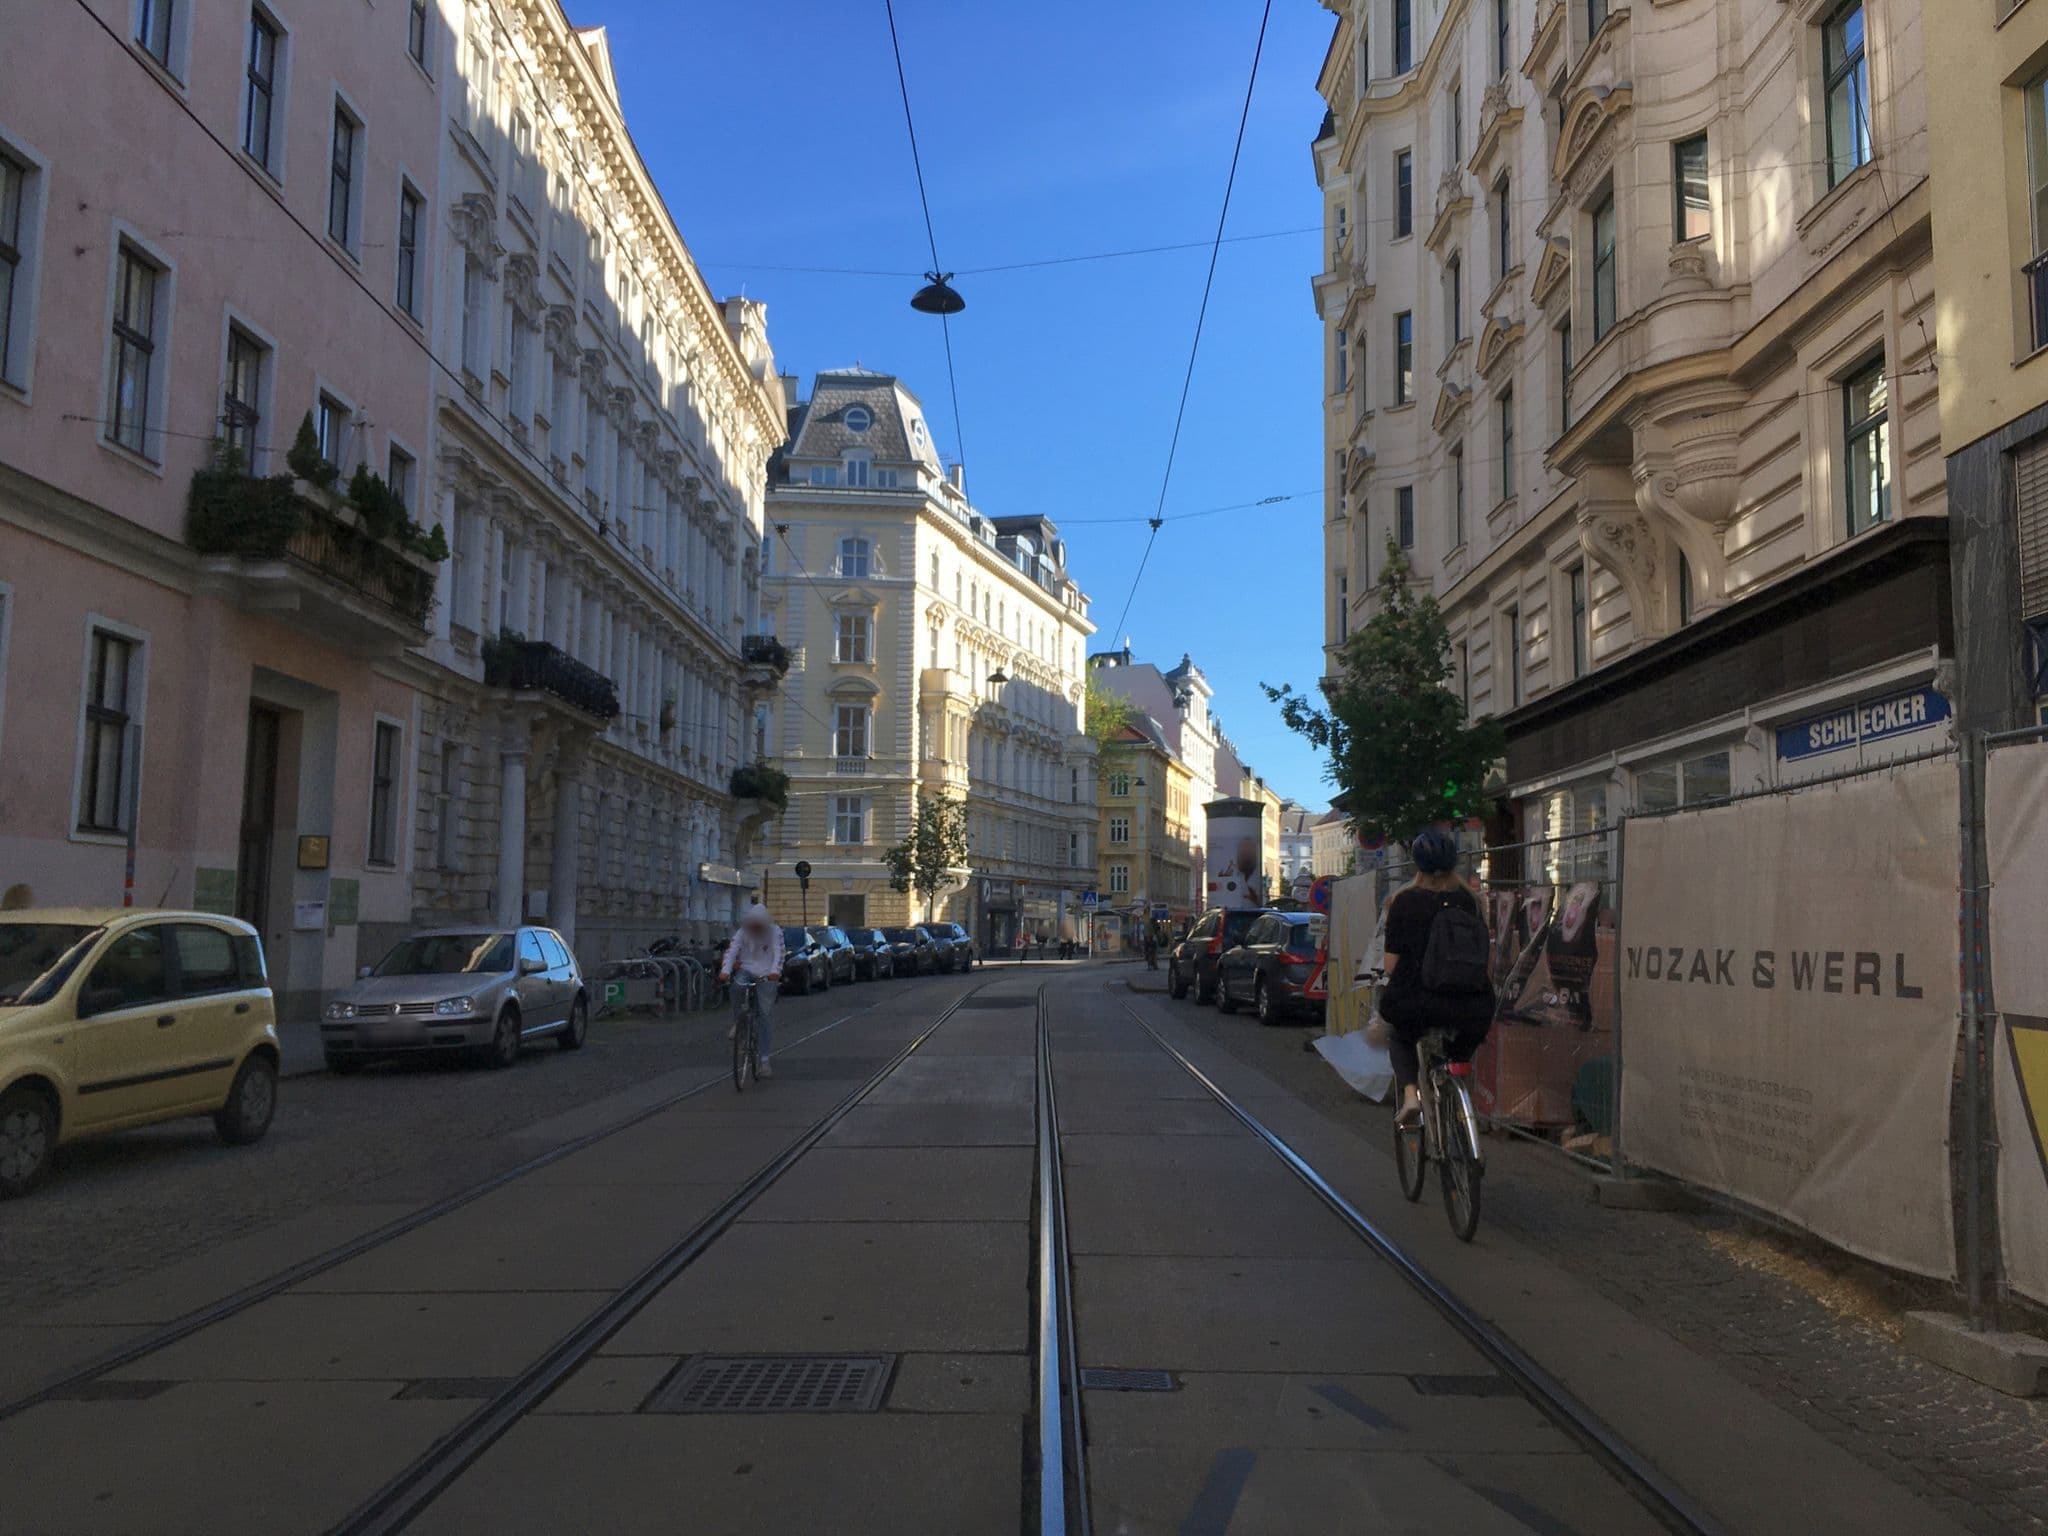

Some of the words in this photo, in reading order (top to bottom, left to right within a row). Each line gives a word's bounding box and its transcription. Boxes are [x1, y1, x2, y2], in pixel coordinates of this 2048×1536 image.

[1809, 694, 1926, 749] SCHLECKER
[604, 984, 620, 1002] P
[1752, 950, 1775, 989] &
[1791, 951, 1924, 999] WERL
